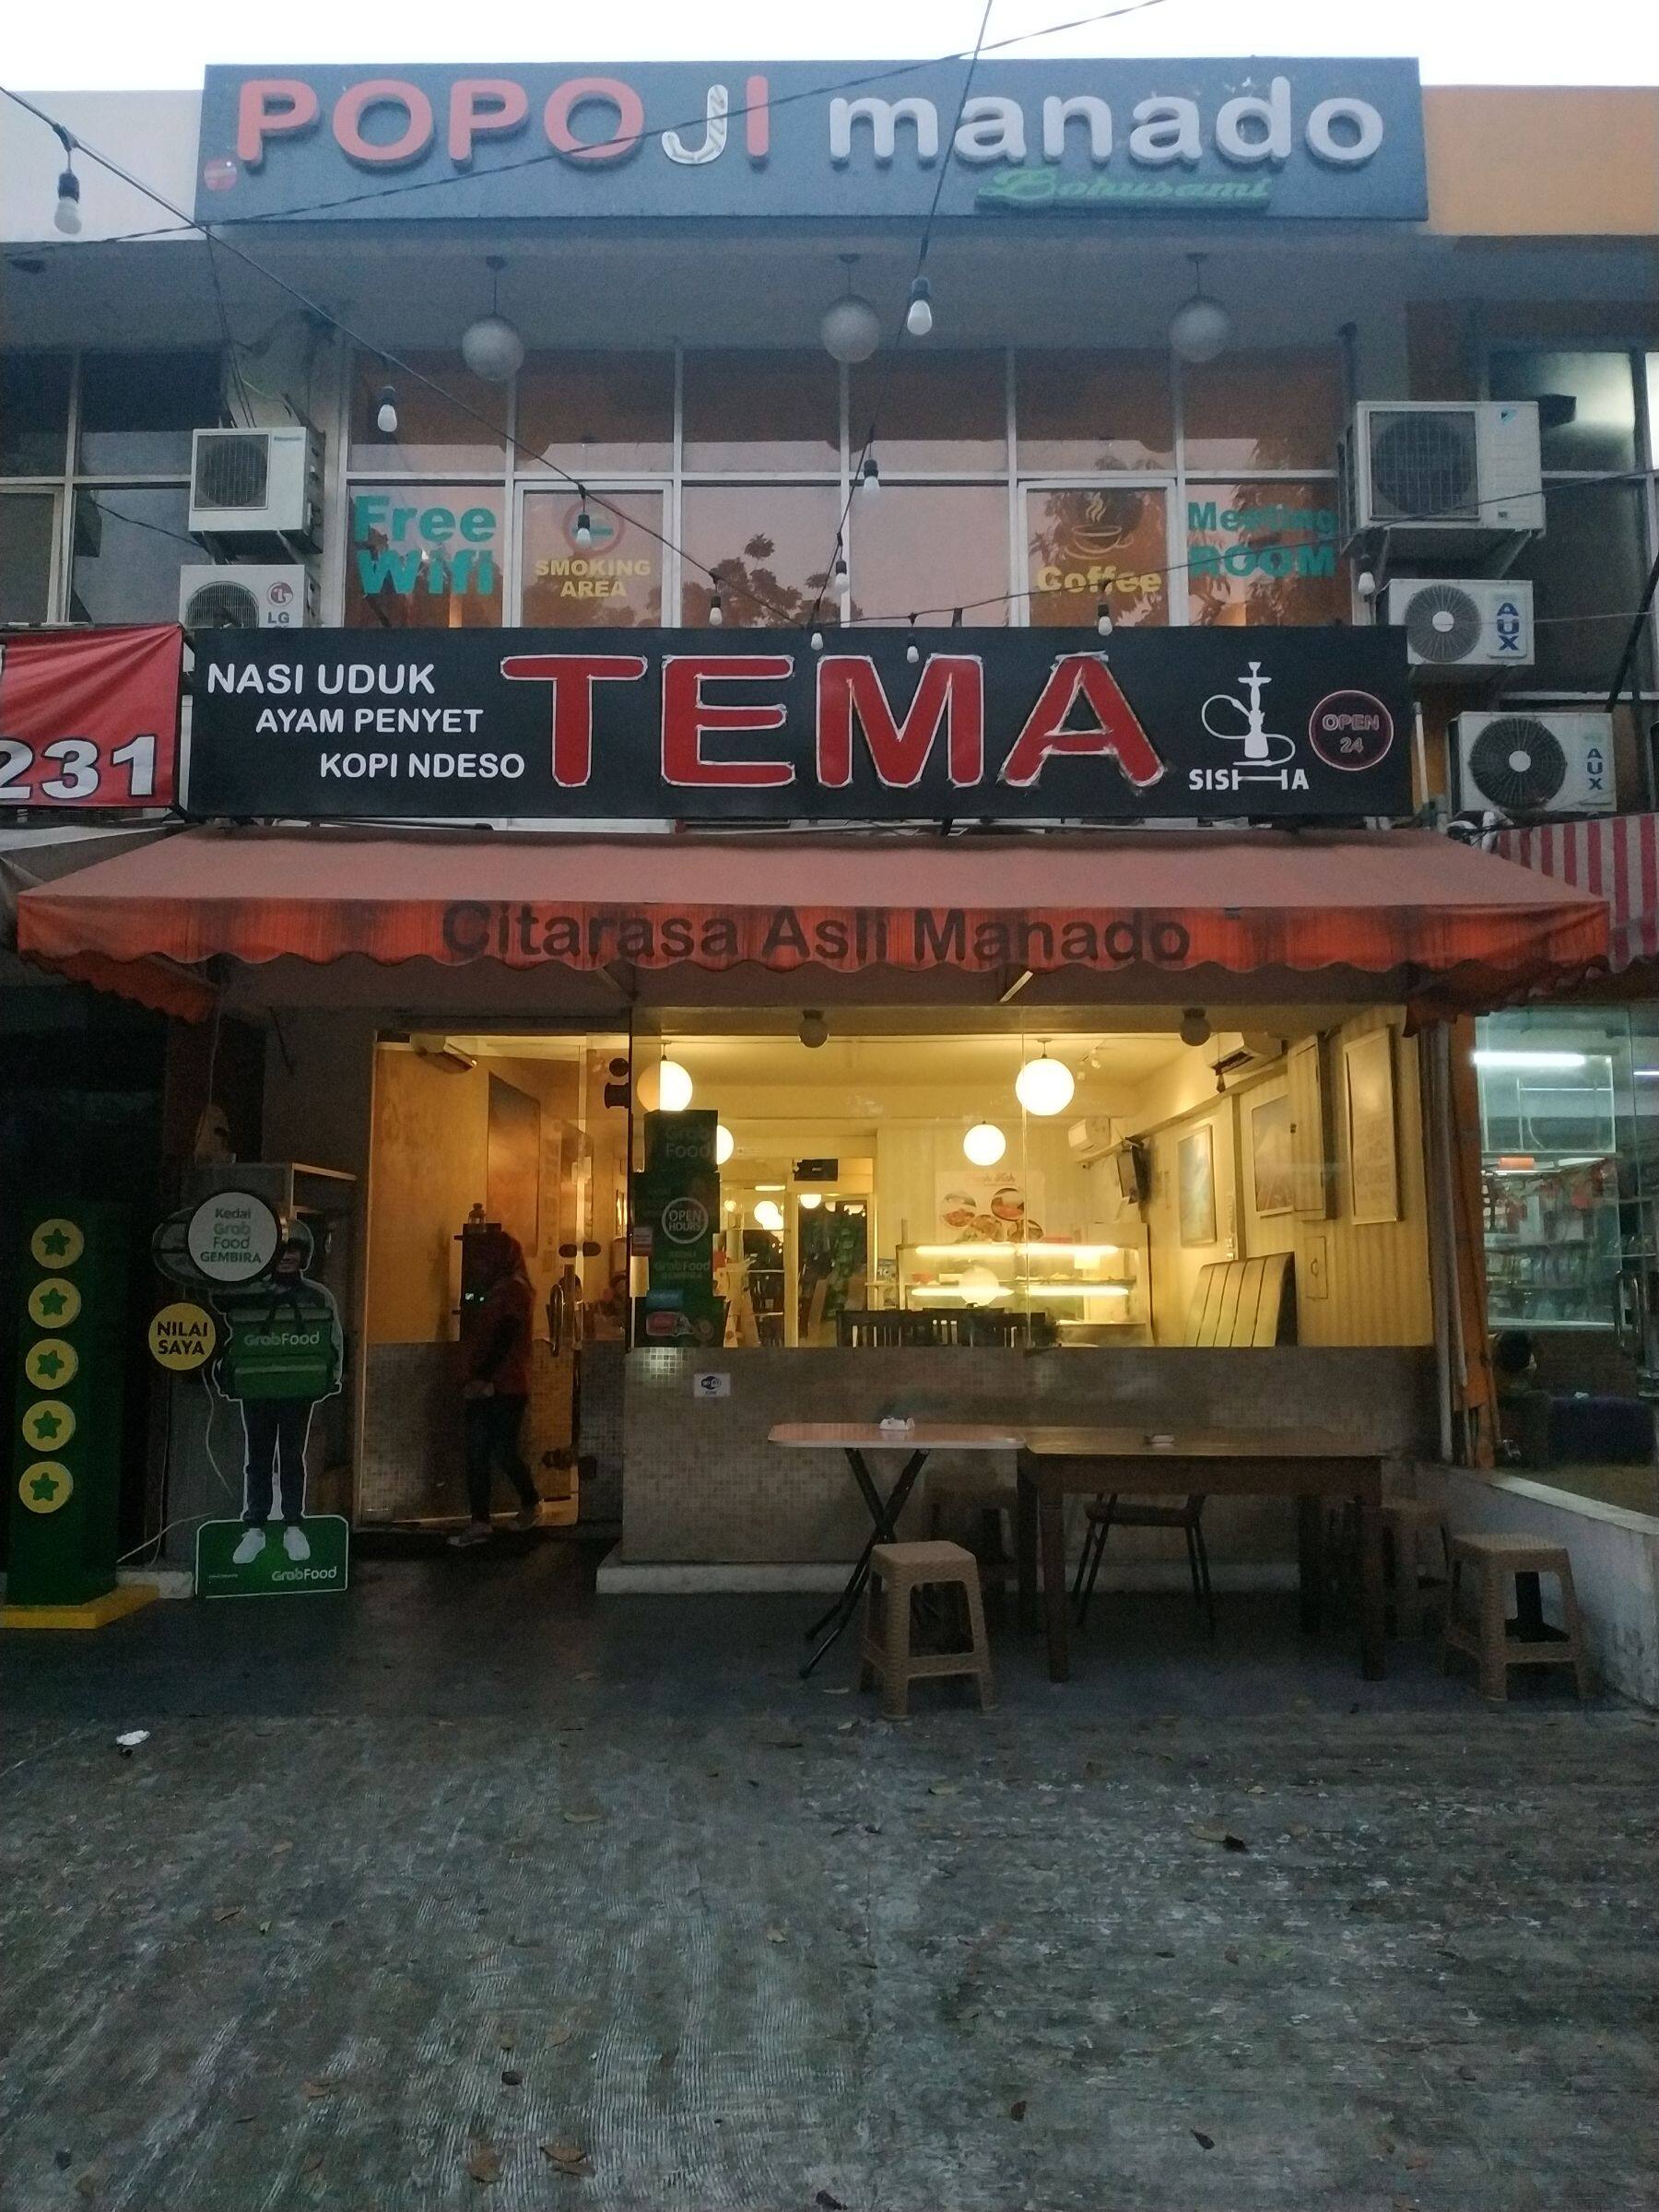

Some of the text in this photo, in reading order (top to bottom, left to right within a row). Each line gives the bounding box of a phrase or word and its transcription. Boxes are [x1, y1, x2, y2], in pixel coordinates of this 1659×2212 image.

[830, 76, 1383, 168] manado
[354, 495, 497, 543] Free
[1187, 501, 1338, 537] Meeting
[535, 559, 652, 576] SMOKING
[1187, 544, 1336, 579] ROOM
[355, 547, 494, 595] Wifi
[1038, 565, 1162, 594] Coffee
[559, 580, 628, 597] AREA
[267, 611, 290, 624] LG
[1497, 602, 1520, 651] AUX
[207, 663, 435, 695] NASI UDUK
[255, 708, 484, 734] AYAM PENYET
[500, 651, 1168, 791] TEMA
[1322, 713, 1380, 732] OPEN
[1339, 736, 1364, 754] 24
[320, 752, 525, 779] KOPI NDESO
[1586, 747, 1604, 791] AUX
[442, 900, 1190, 961] Citarasa Asli Manado
[665, 1142, 711, 1159] Food
[215, 1208, 252, 1218] Kedai
[668, 1209, 701, 1221] OPEN
[213, 1221, 252, 1235] Grab
[668, 1221, 701, 1232] HOURS
[213, 1236, 251, 1249] Food
[200, 1251, 262, 1264] GEMBIRA
[157, 1321, 208, 1336] NILAI
[158, 1339, 206, 1355] SAYA
[243, 1331, 320, 1346] GrabFood
[271, 1566, 338, 1582] GrabFood
